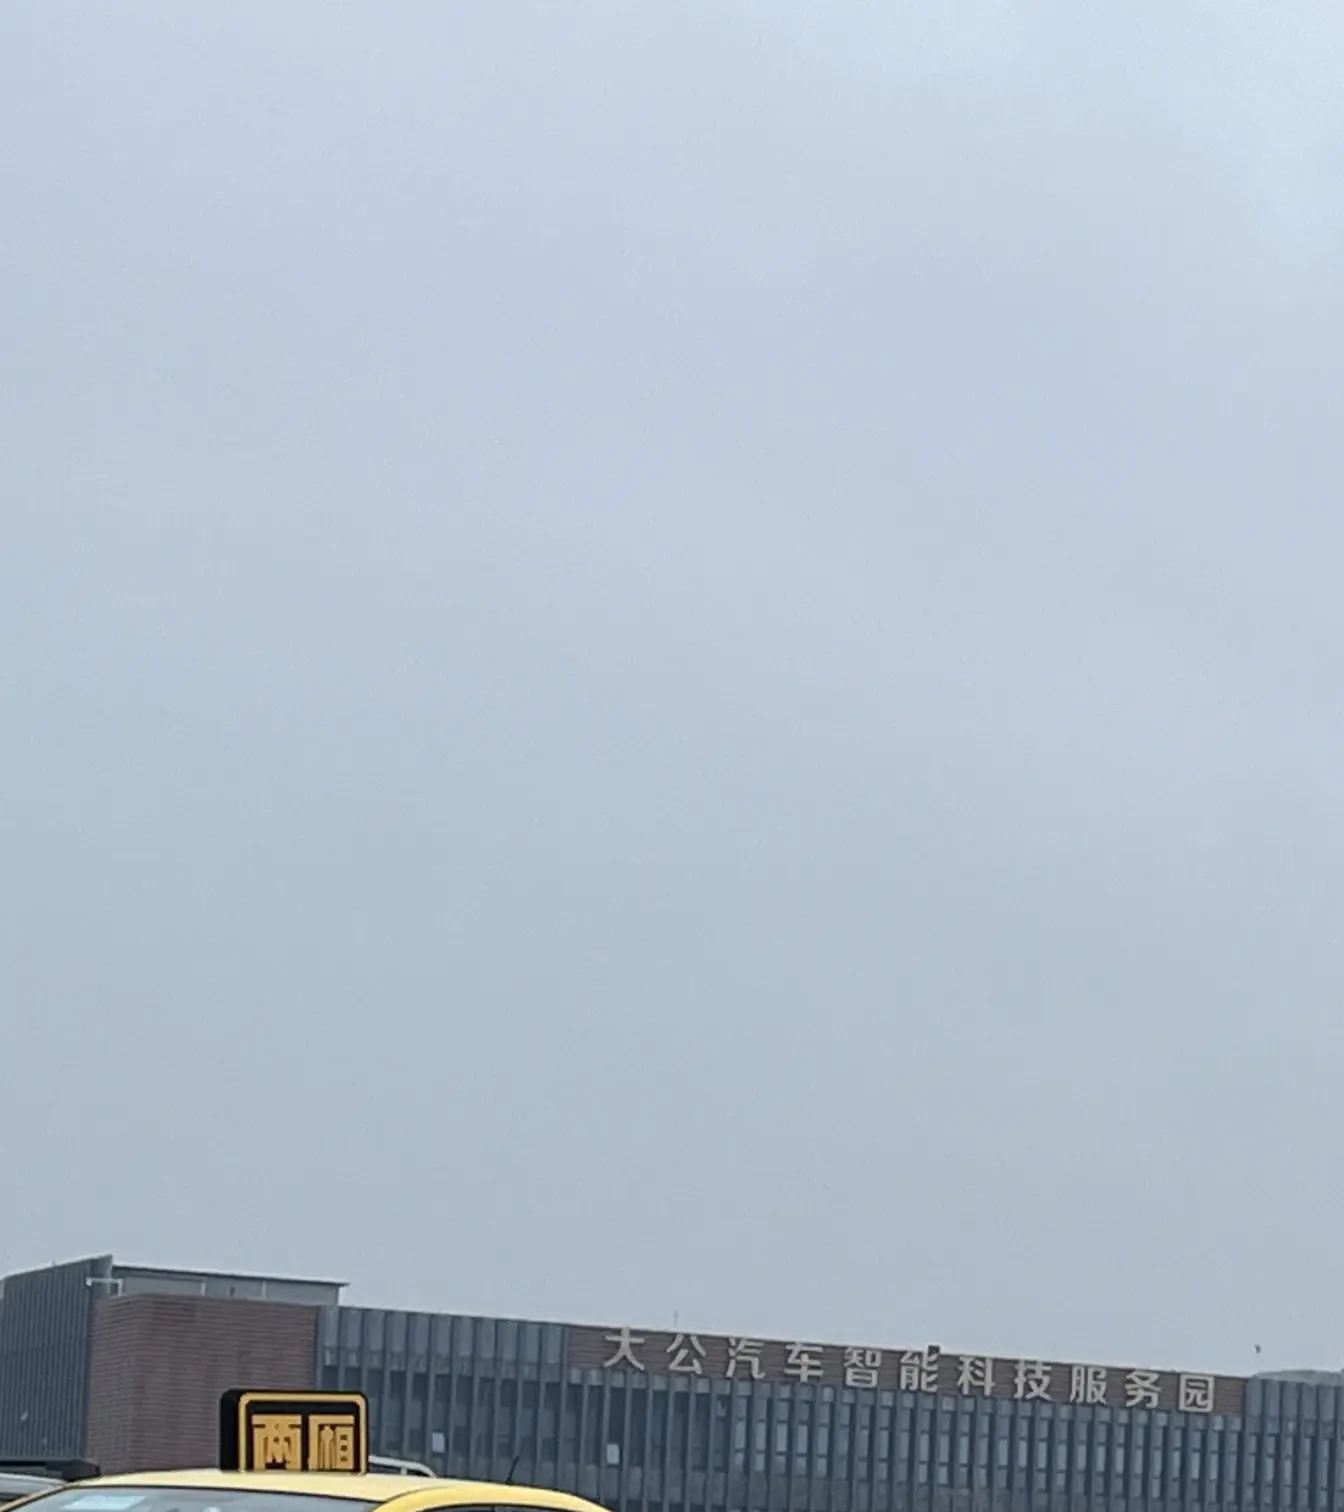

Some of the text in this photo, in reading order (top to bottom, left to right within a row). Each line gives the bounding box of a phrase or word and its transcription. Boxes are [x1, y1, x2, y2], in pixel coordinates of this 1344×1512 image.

[604, 1326, 1216, 1413] 大公汽车智能科技服务园
